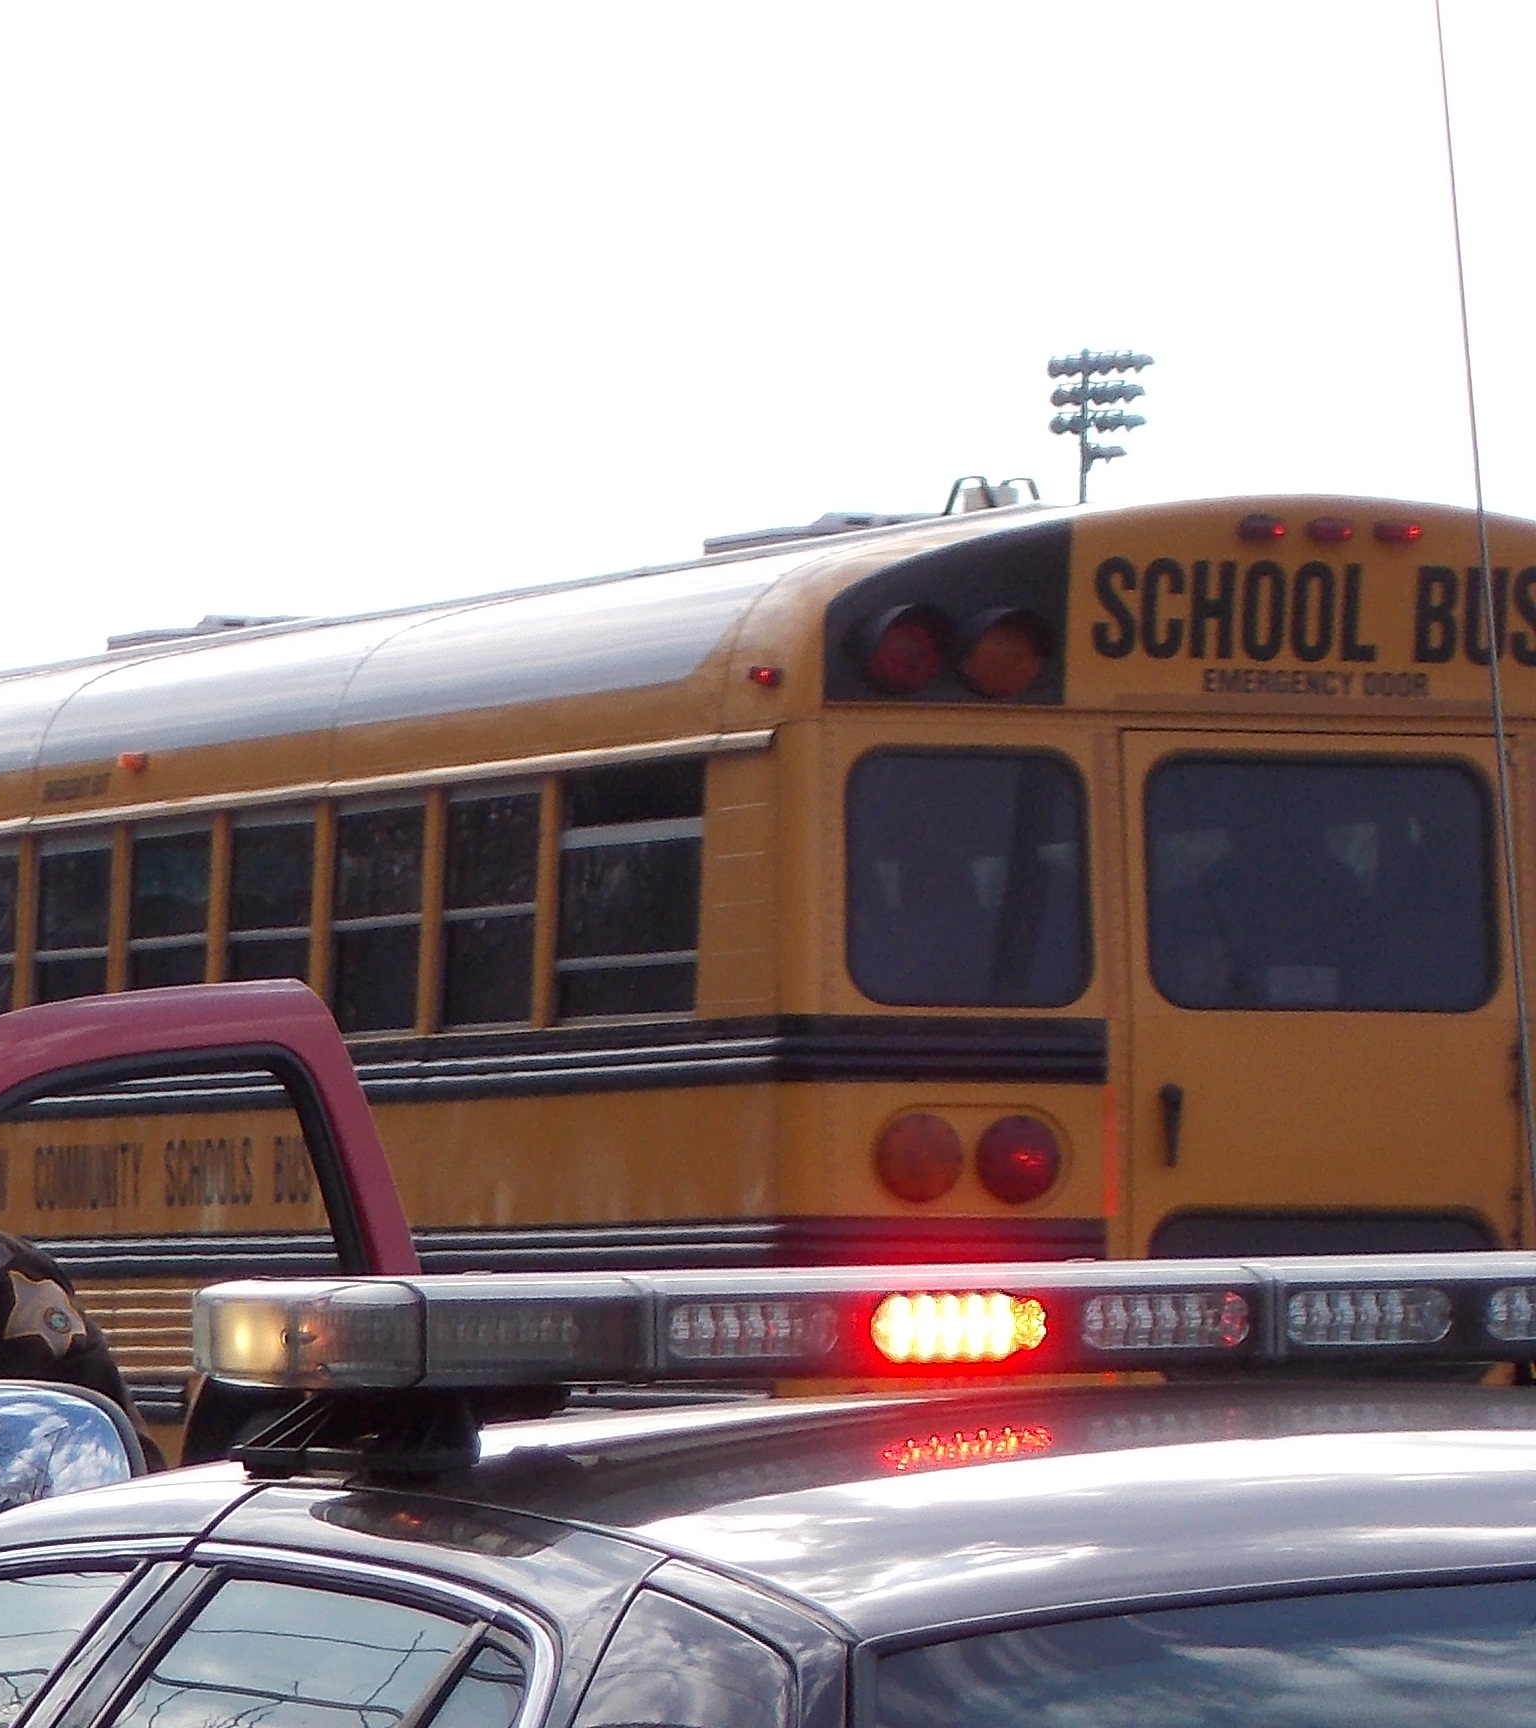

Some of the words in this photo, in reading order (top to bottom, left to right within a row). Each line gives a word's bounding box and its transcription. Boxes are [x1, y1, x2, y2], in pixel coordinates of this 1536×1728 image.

[1092, 556, 1377, 663] SCHOOL
[1412, 562, 1536, 669] BUS
[1202, 667, 1353, 698] EMERGENCY
[1363, 671, 1430, 699] DOOR
[32, 1141, 146, 1212] COMMUNITY
[164, 1135, 253, 1208] SCHOOLS
